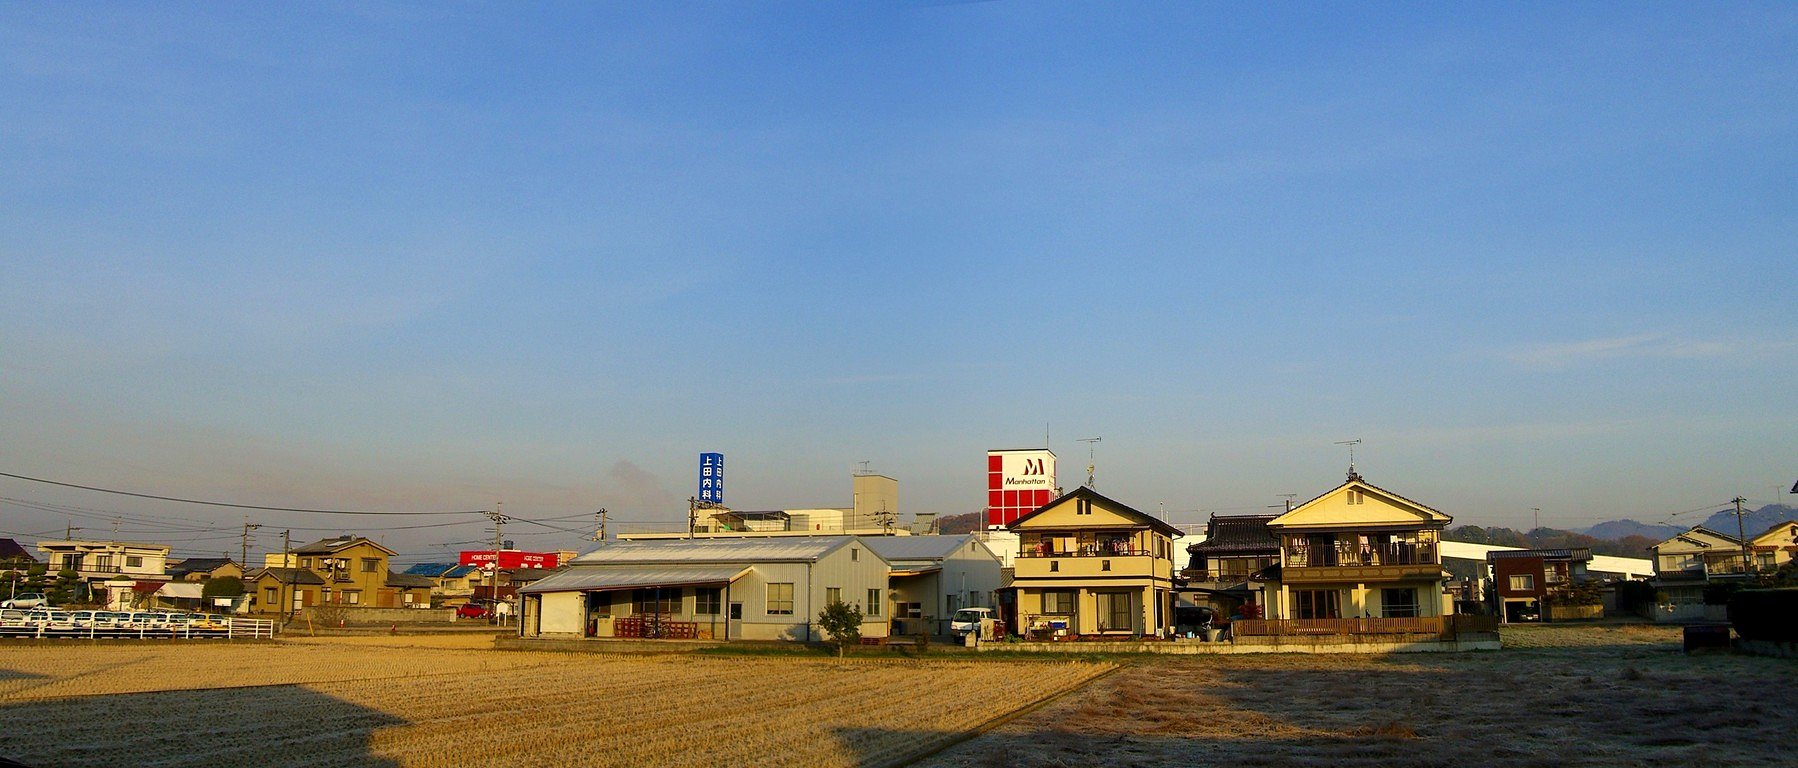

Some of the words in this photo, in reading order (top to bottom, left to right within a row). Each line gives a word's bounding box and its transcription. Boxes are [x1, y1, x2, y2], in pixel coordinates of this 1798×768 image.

[702, 456, 712, 499] 上田内科
[1005, 477, 1045, 485] Manhattan
